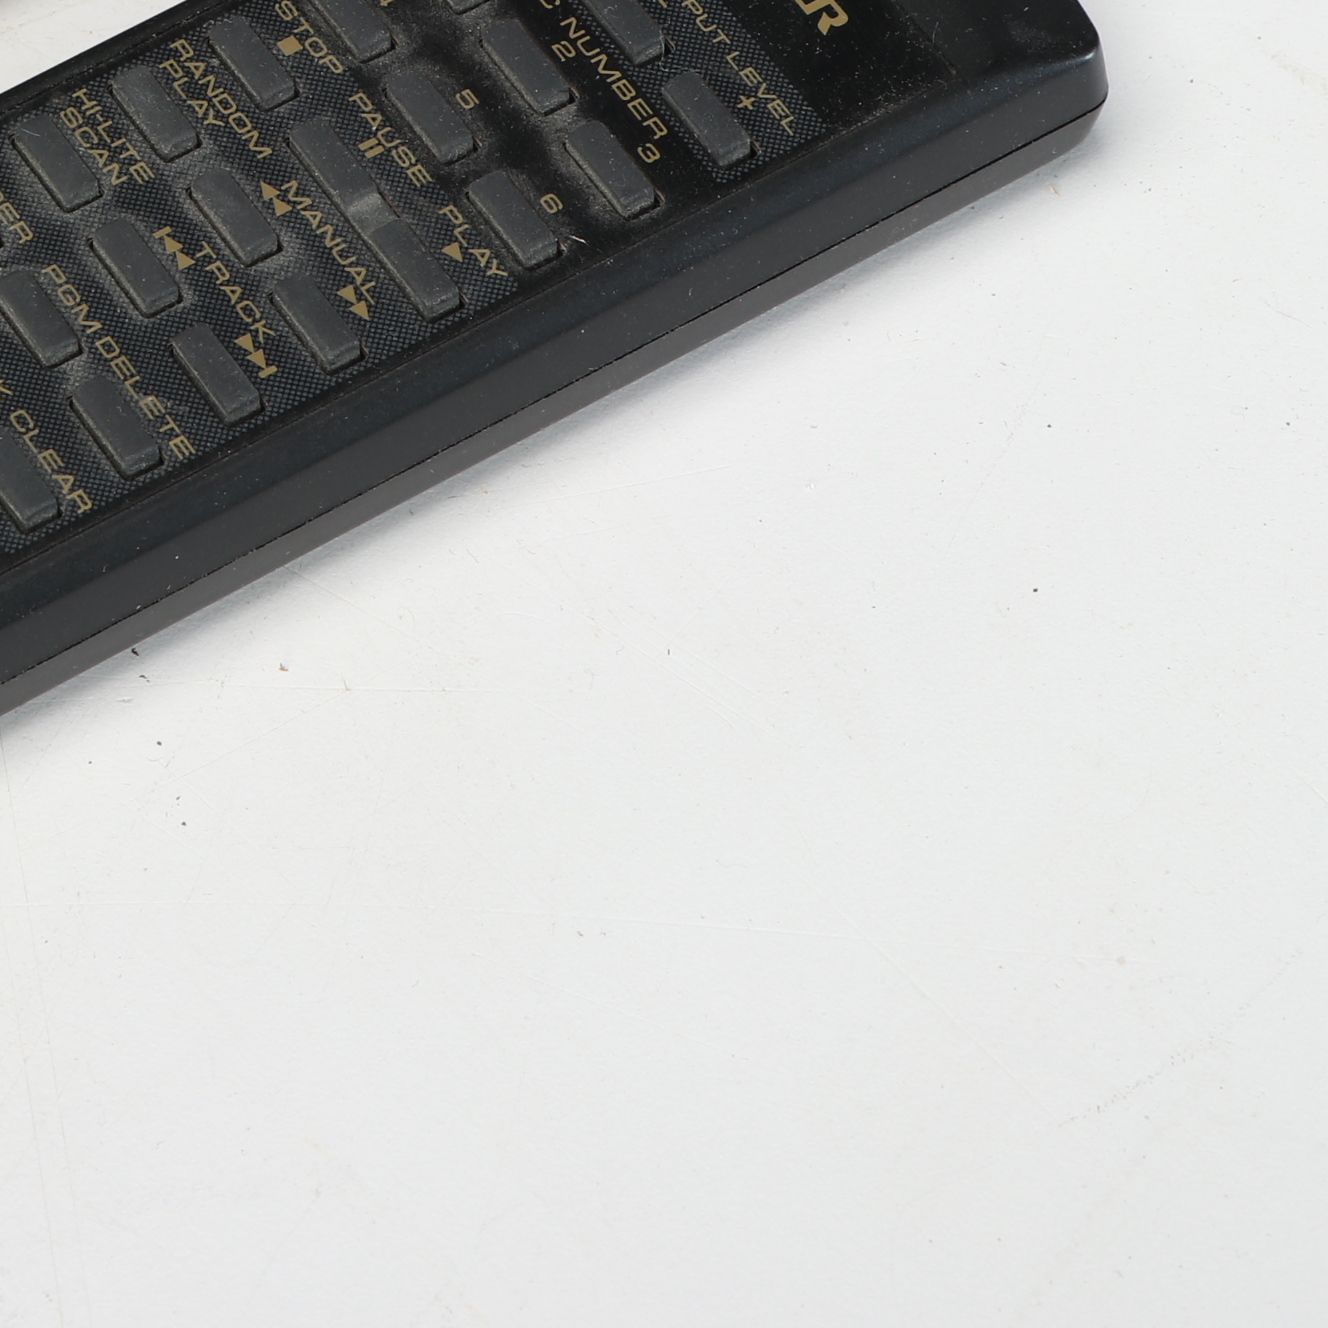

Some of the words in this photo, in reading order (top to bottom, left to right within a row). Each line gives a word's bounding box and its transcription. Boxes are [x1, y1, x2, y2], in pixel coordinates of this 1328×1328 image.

[274, 0, 345, 74] STOP
[551, 41, 576, 62] 2
[559, 16, 668, 141] NUMBER
[72, 88, 155, 185] HI-LITE
[159, 60, 225, 129] PLAY
[169, 39, 273, 160] RANDOM
[455, 89, 480, 109] 5
[726, 50, 799, 137] LEVEL
[59, 106, 130, 187] SCAN
[348, 91, 432, 188] PAUSE
[637, 144, 661, 164] 3
[280, 179, 375, 304] MANUAL
[438, 205, 509, 278] PLAY
[539, 193, 564, 214] 6
[195, 240, 275, 340] TRACK
[41, 264, 102, 334] PGM
[95, 336, 196, 461] DELETE
[9, 409, 94, 515] CLEAR
